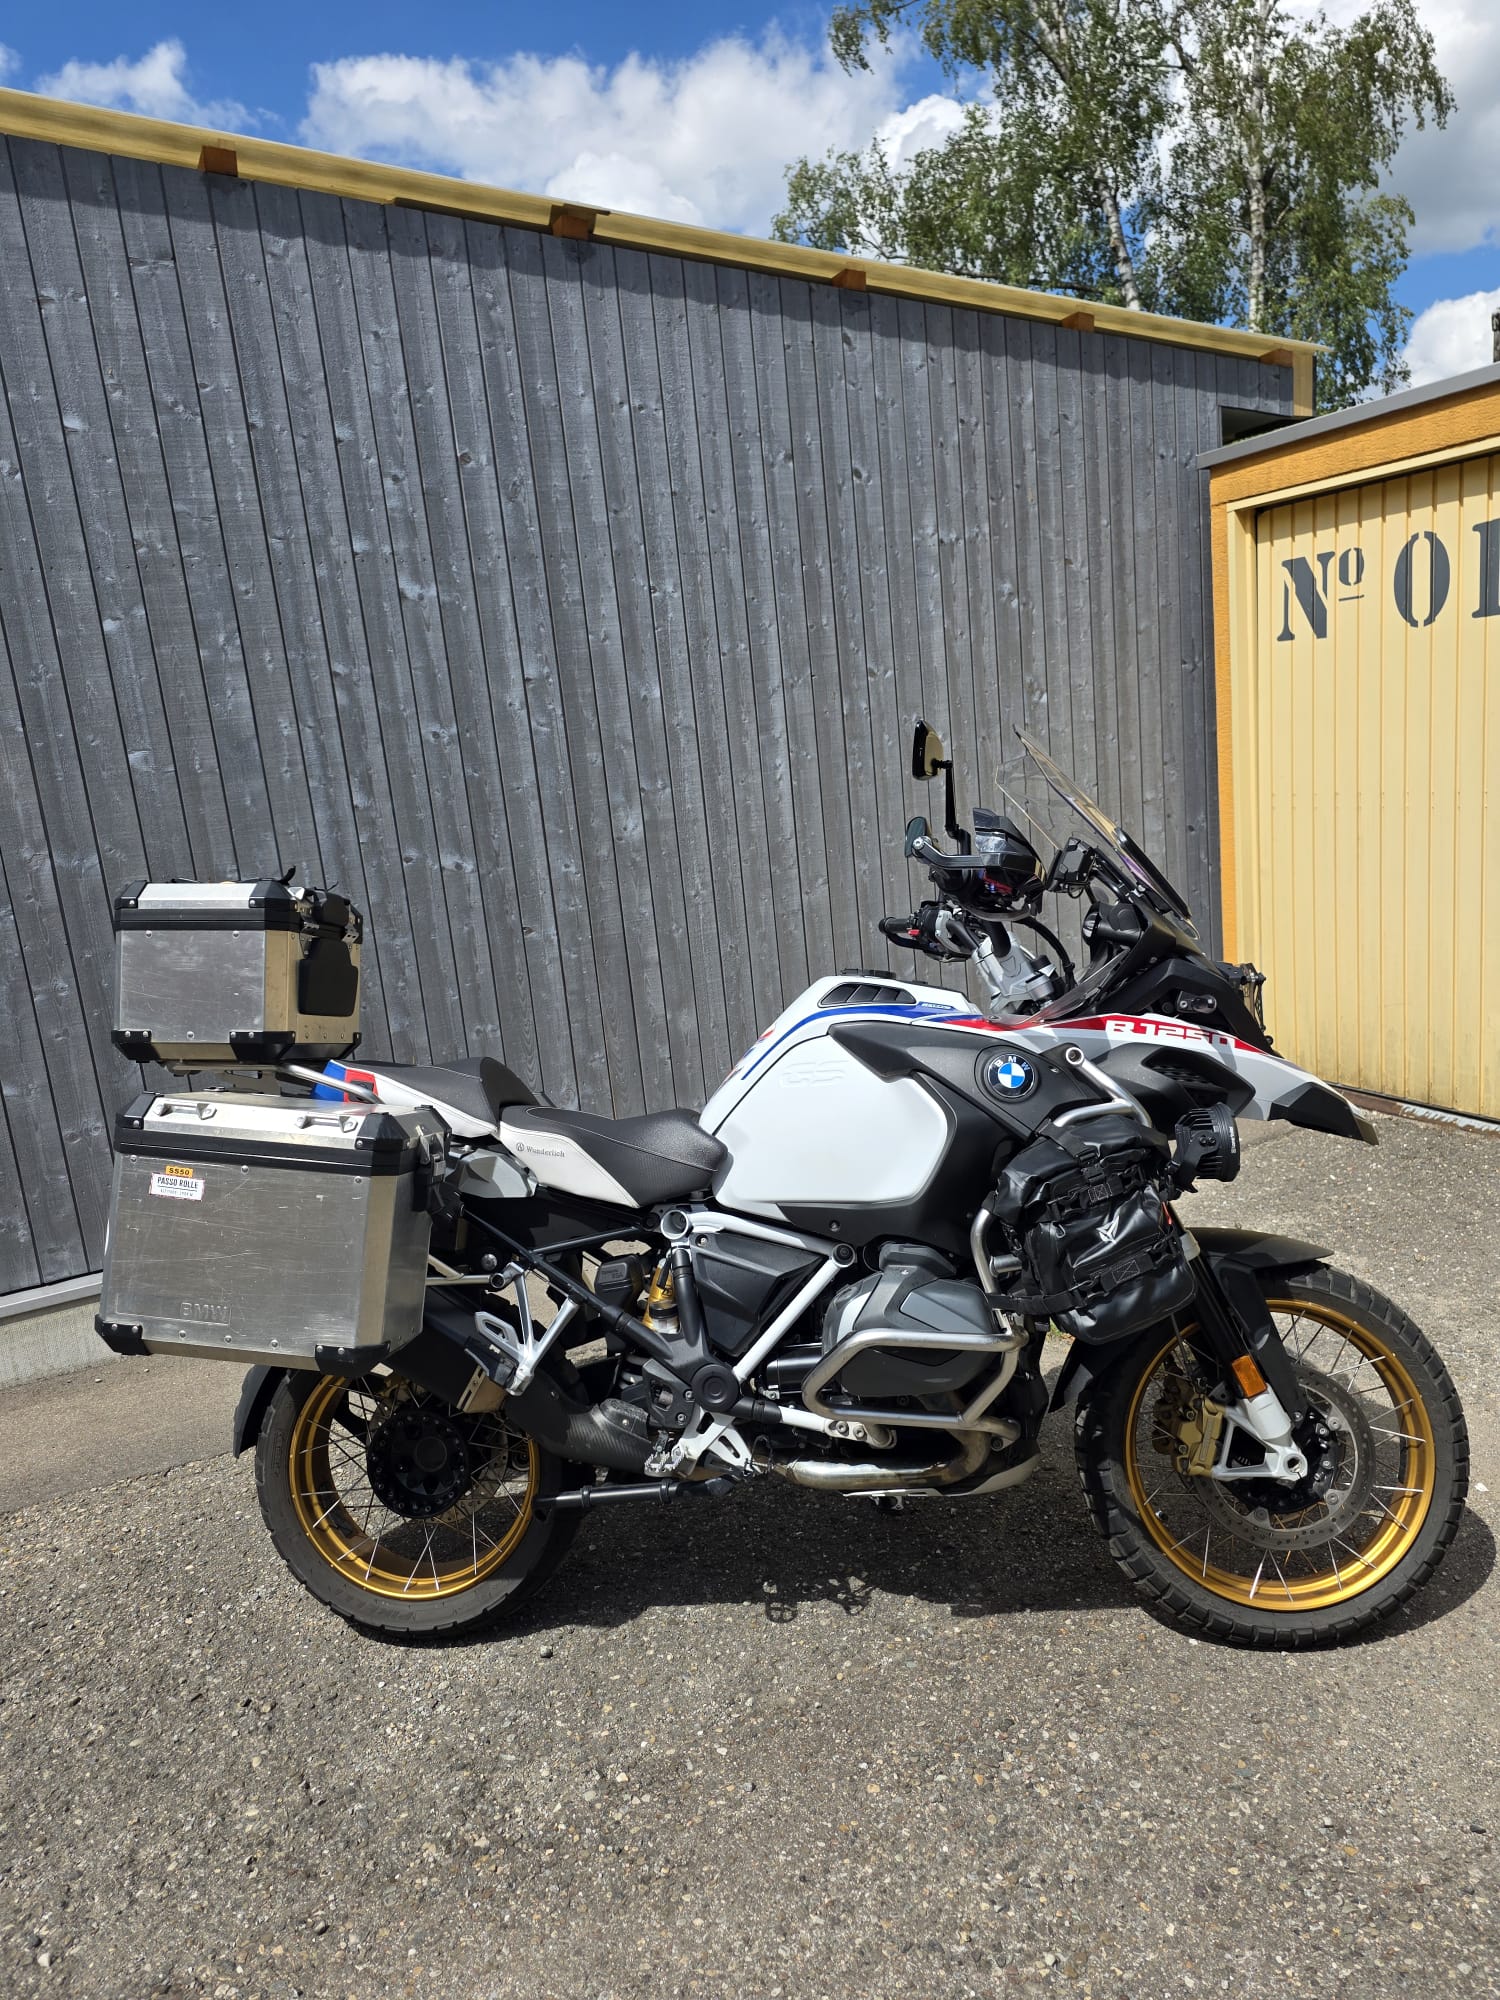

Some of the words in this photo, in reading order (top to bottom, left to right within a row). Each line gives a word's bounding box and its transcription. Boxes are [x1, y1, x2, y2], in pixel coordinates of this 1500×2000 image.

[994, 1056, 1030, 1071] BMW
[526, 1145, 565, 1158] Wunderlich
[157, 1176, 178, 1187] PASSO
[179, 1179, 199, 1189] ROLLE
[180, 1302, 229, 1322] BMW
